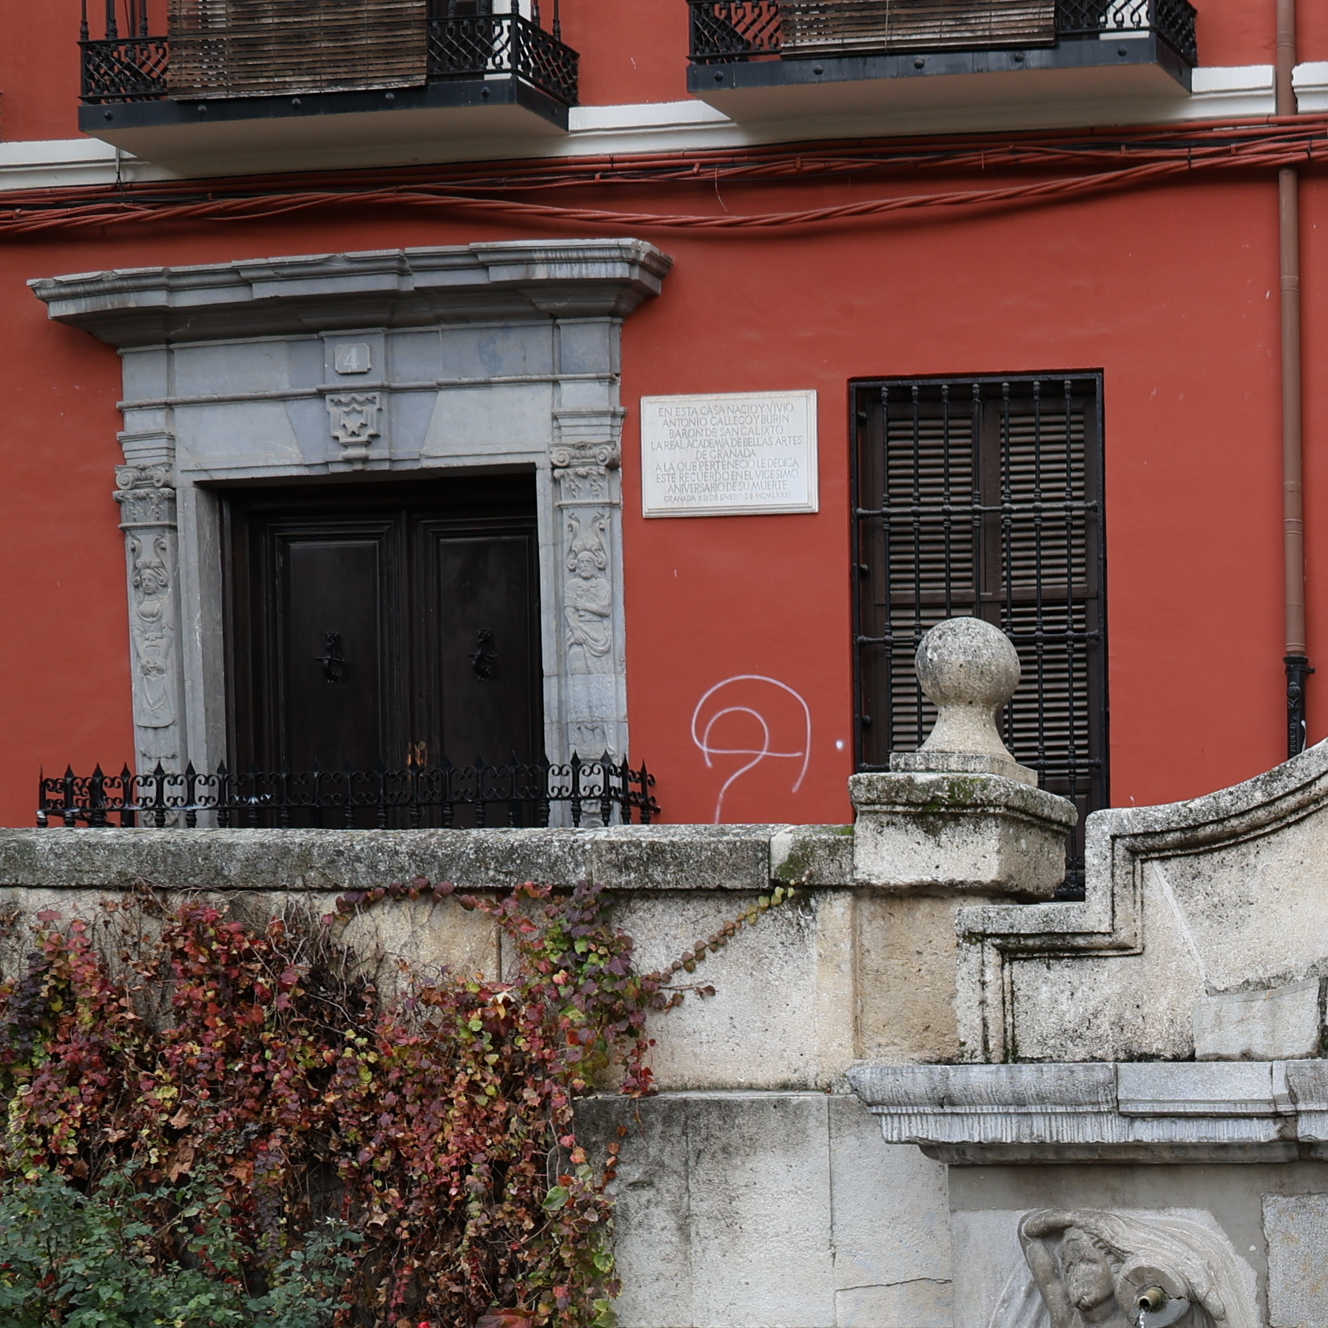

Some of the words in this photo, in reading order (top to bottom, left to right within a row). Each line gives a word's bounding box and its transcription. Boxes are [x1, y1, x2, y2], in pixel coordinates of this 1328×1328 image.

[658, 407, 672, 416] EN
[676, 406, 698, 416] ESTA
[664, 417, 708, 427] ANTONIO
[650, 439, 663, 450] LA
[656, 472, 676, 483] ESTE
